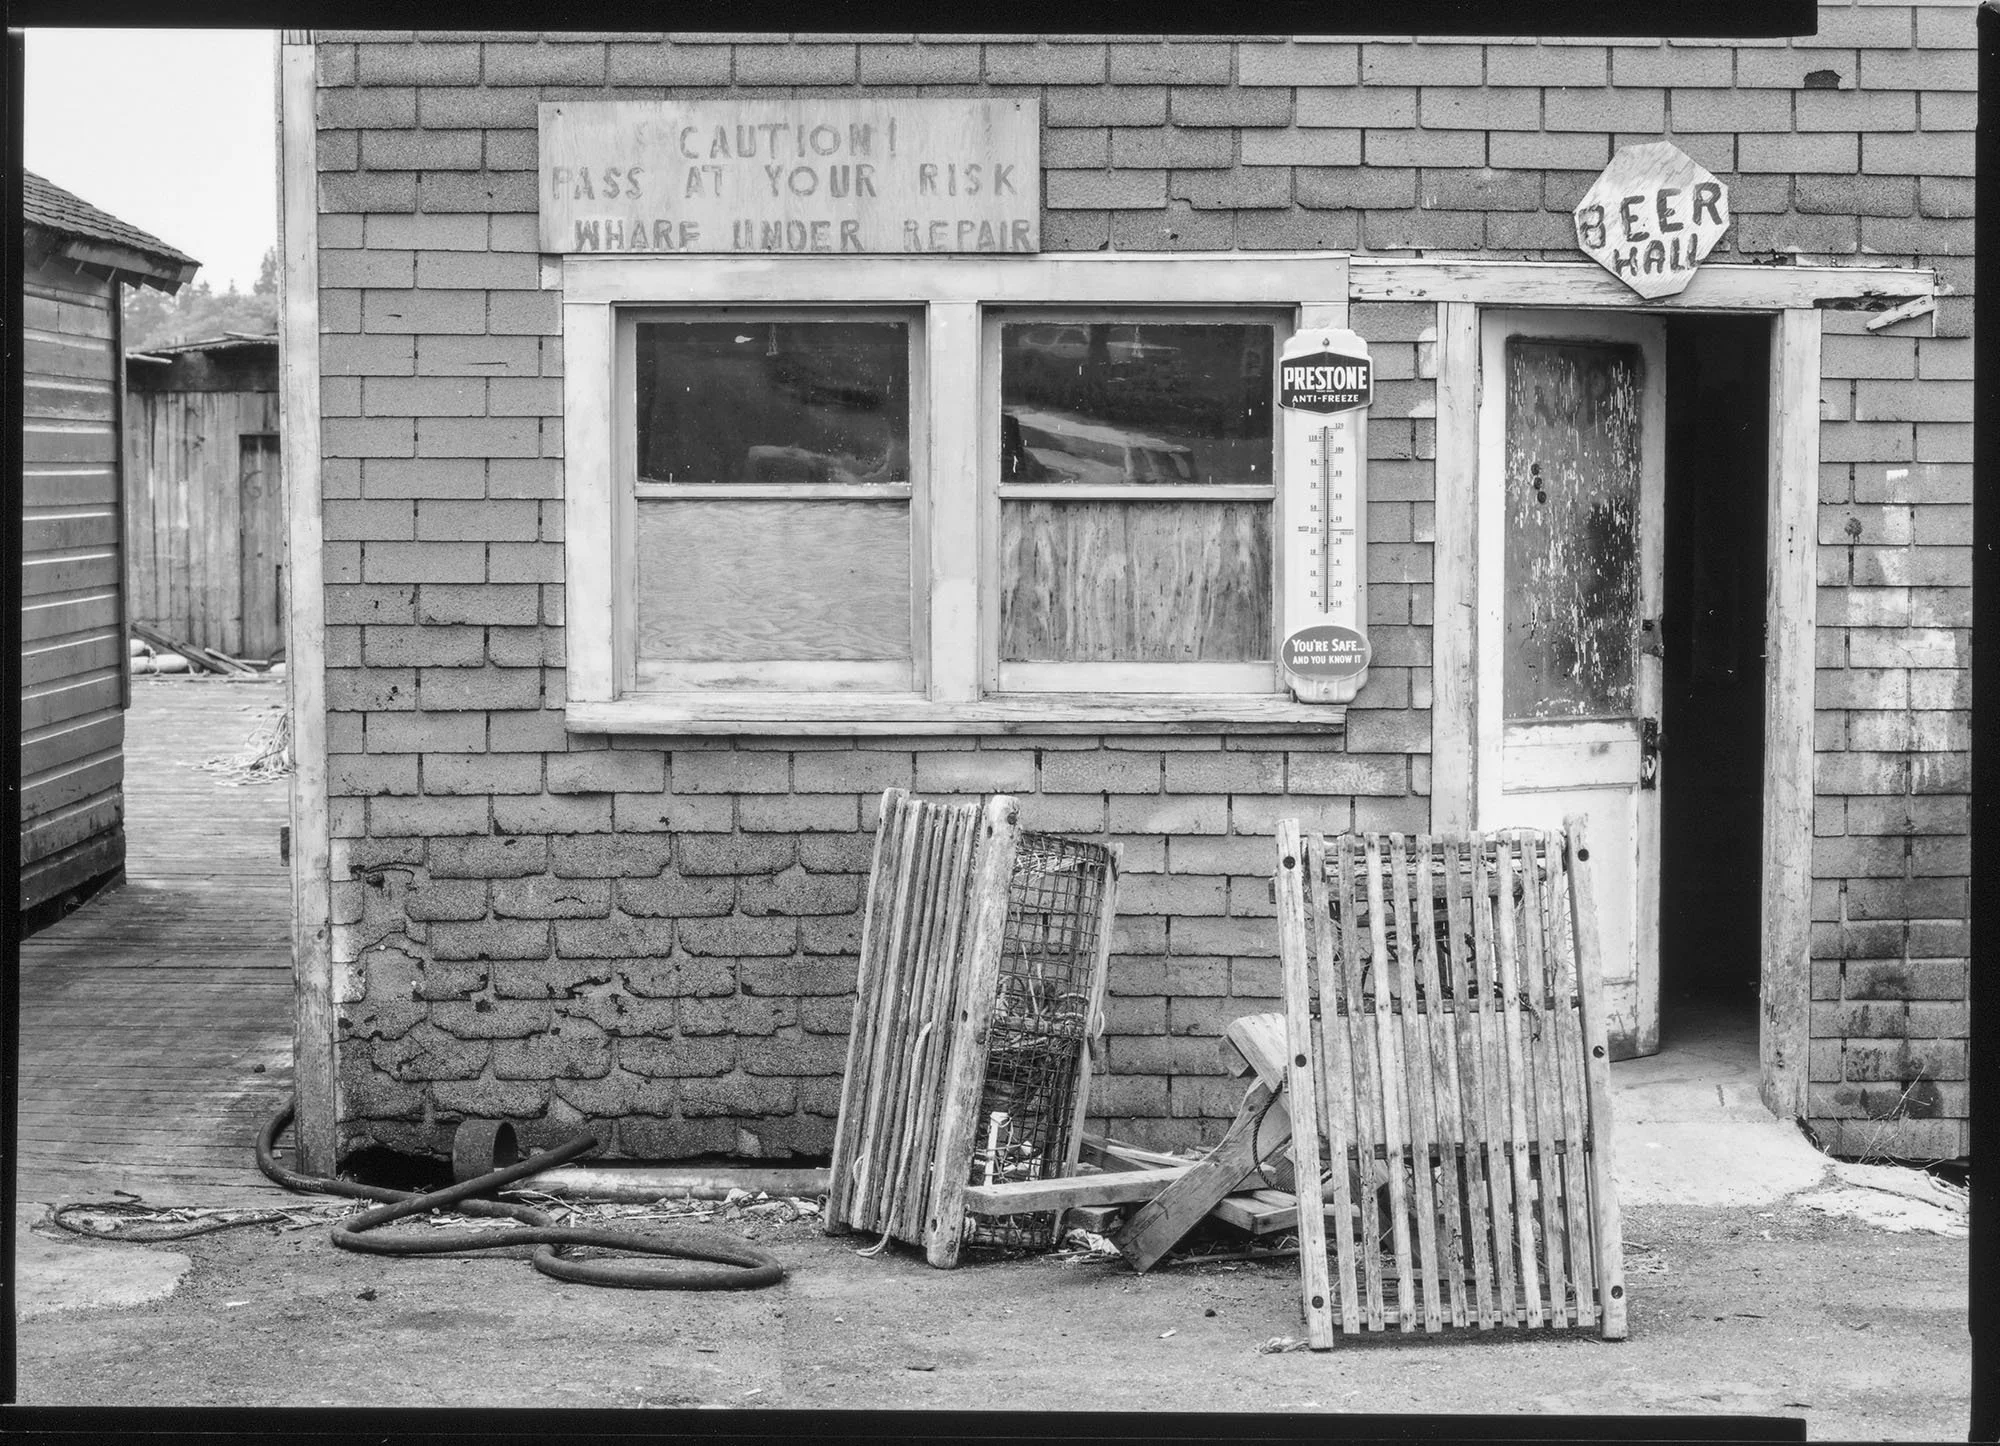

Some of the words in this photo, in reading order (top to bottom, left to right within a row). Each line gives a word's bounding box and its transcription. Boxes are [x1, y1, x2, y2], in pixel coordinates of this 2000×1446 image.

[552, 166, 645, 200] PASS
[684, 164, 726, 199] AT
[764, 163, 877, 199] YOUR
[919, 163, 1017, 197] RISK
[1578, 181, 1723, 249] BEER
[574, 219, 701, 251] WHARF
[733, 219, 865, 251] UNDER
[903, 218, 1033, 251] REPAIR
[1612, 232, 1702, 278] HALL
[1283, 366, 1368, 391] PRESTONE
[1291, 394, 1360, 403] ANTI-FREEZE
[1291, 638, 1329, 653] YOU'RE
[1292, 655, 1309, 665] AND
[1310, 655, 1327, 665] YOU
[1328, 654, 1352, 665] KNOW
[1354, 654, 1362, 664] IT
